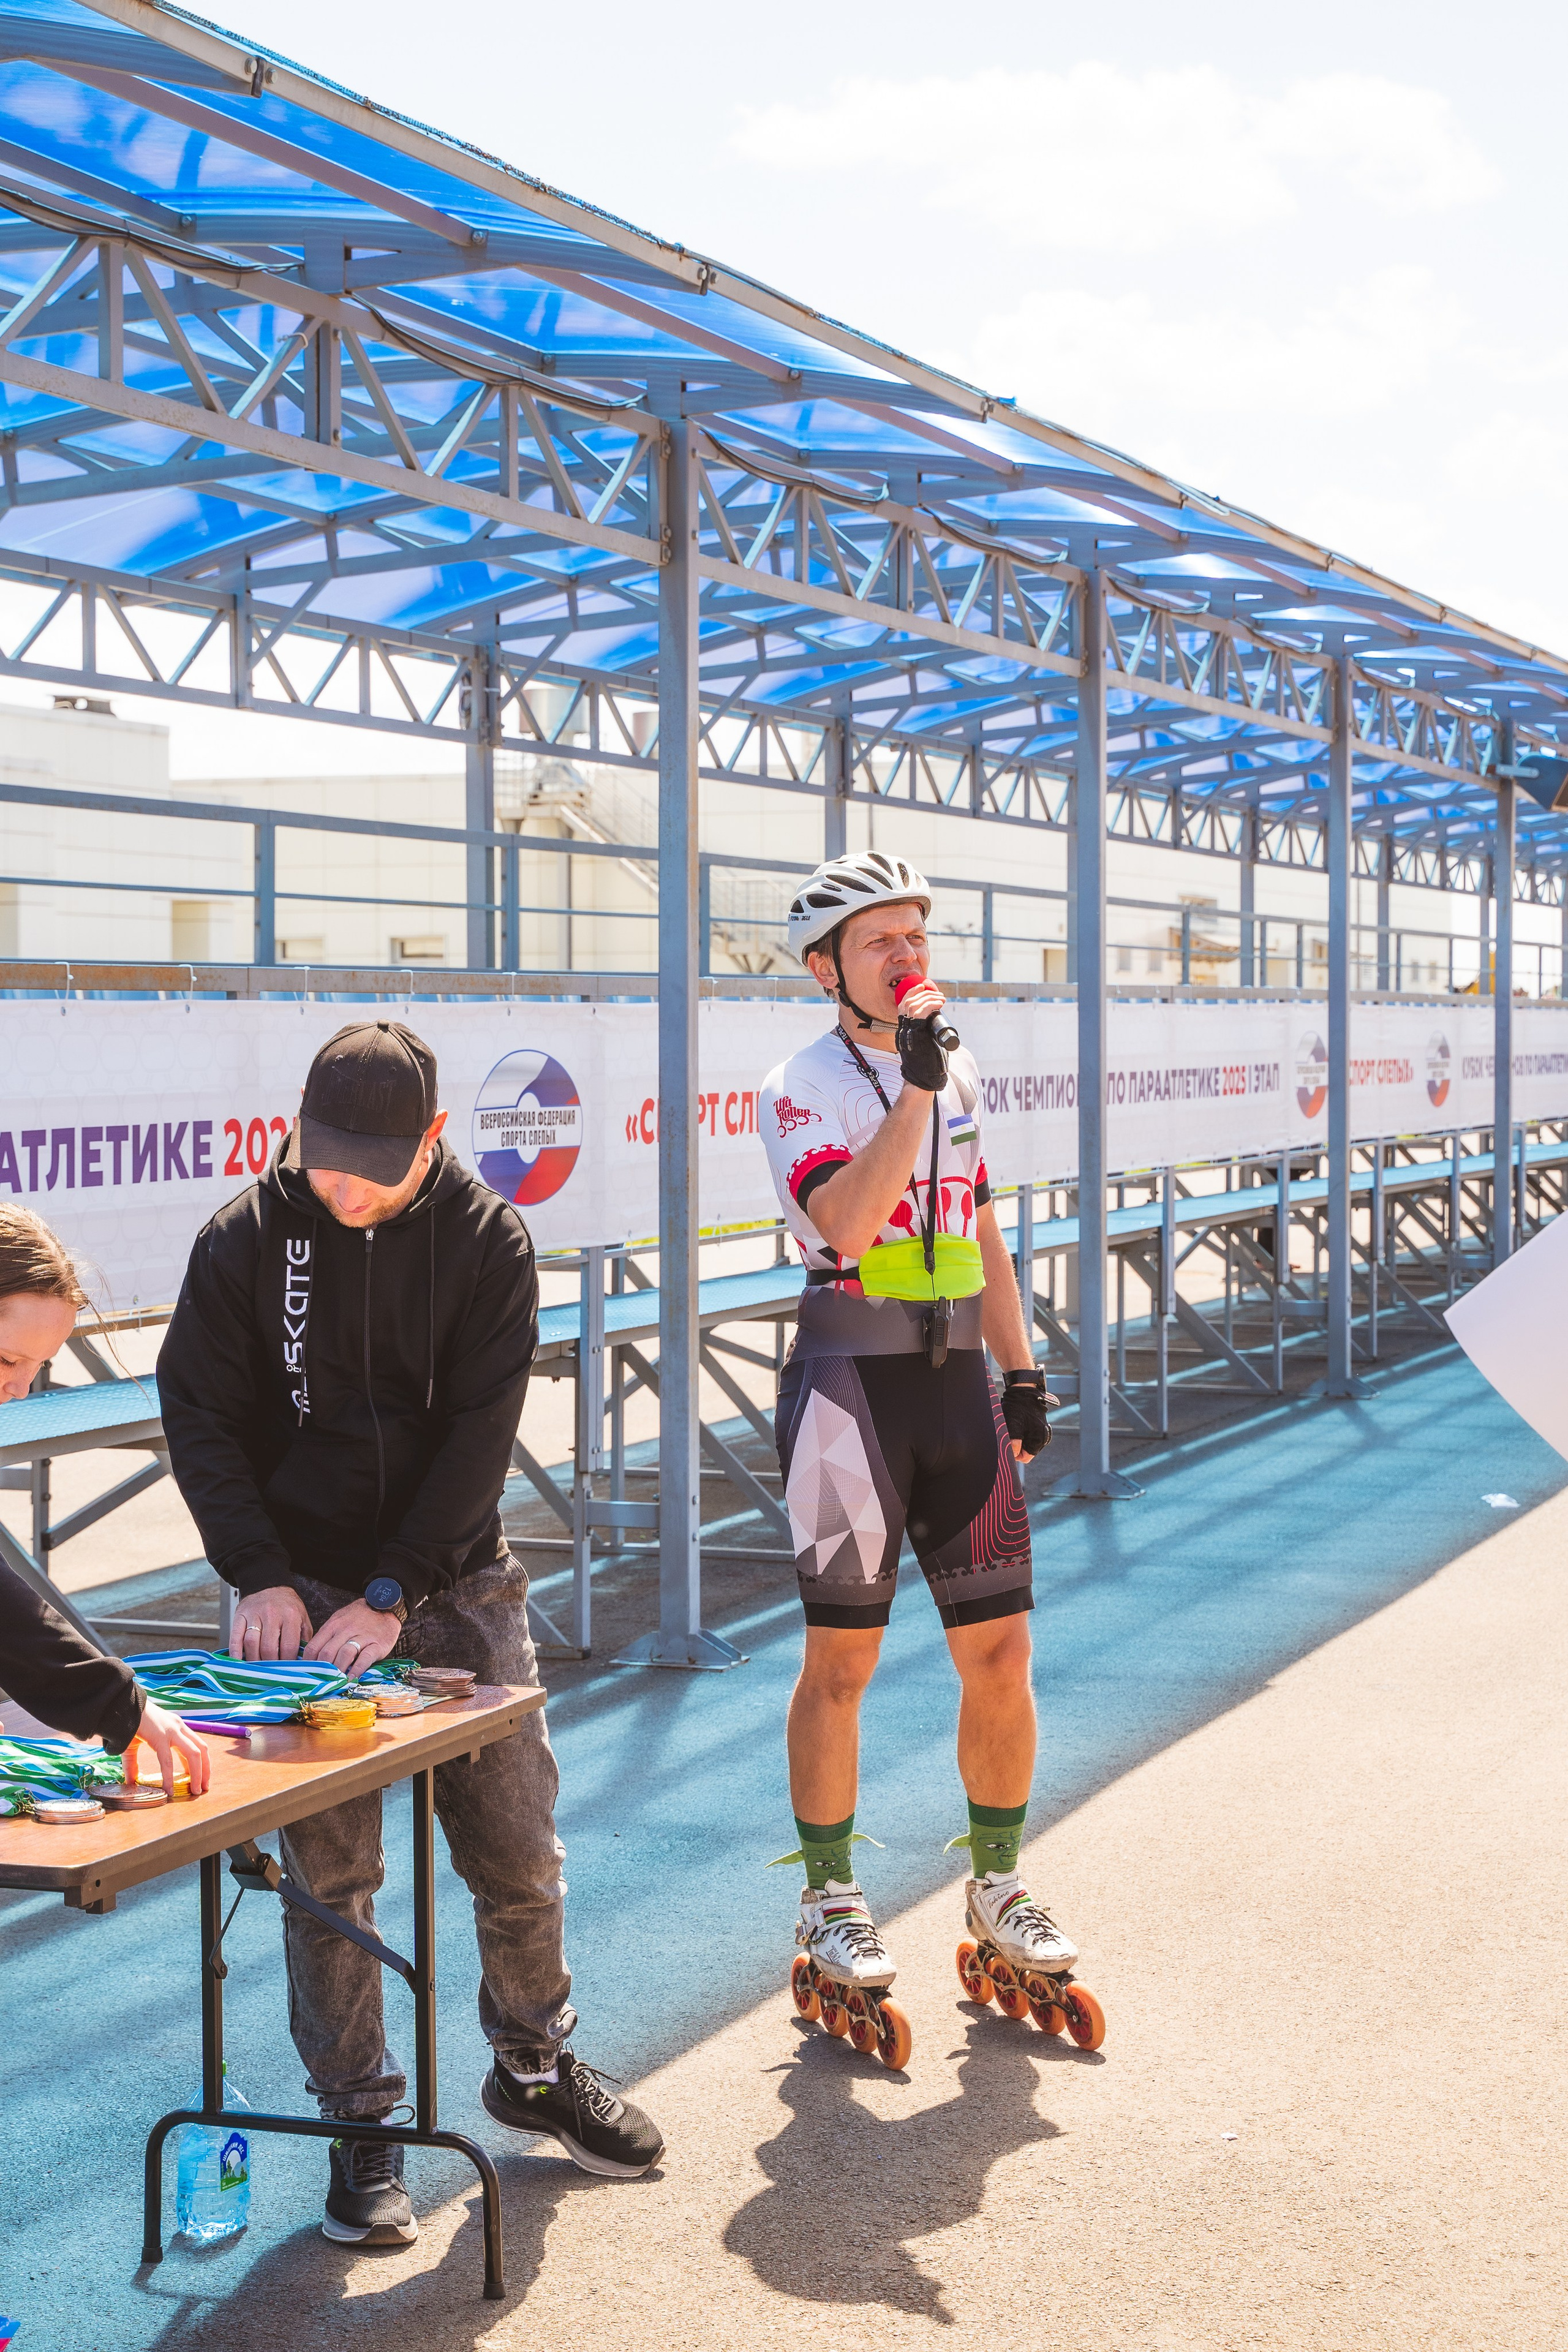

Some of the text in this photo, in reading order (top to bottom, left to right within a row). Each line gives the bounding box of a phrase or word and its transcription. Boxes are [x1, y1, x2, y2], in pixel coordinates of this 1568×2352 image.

[1014, 1073, 1080, 1112] ЧЕМПИО
[1107, 1072, 1125, 1104] ПО
[1129, 1067, 1219, 1103] ПАРААТЛЕТИКЕ
[1223, 1065, 1246, 1096] 2025
[1254, 1062, 1280, 1094] ЭТАП
[480, 1109, 575, 1129] ВСЕРОССИЙСКАЯ ФЕДЕРАЦИЯ
[224, 1116, 296, 1176] 20
[501, 1129, 556, 1147] СПОРТА СЛЕПЫХ
[222, 2142, 238, 2162] ШИШКИН
